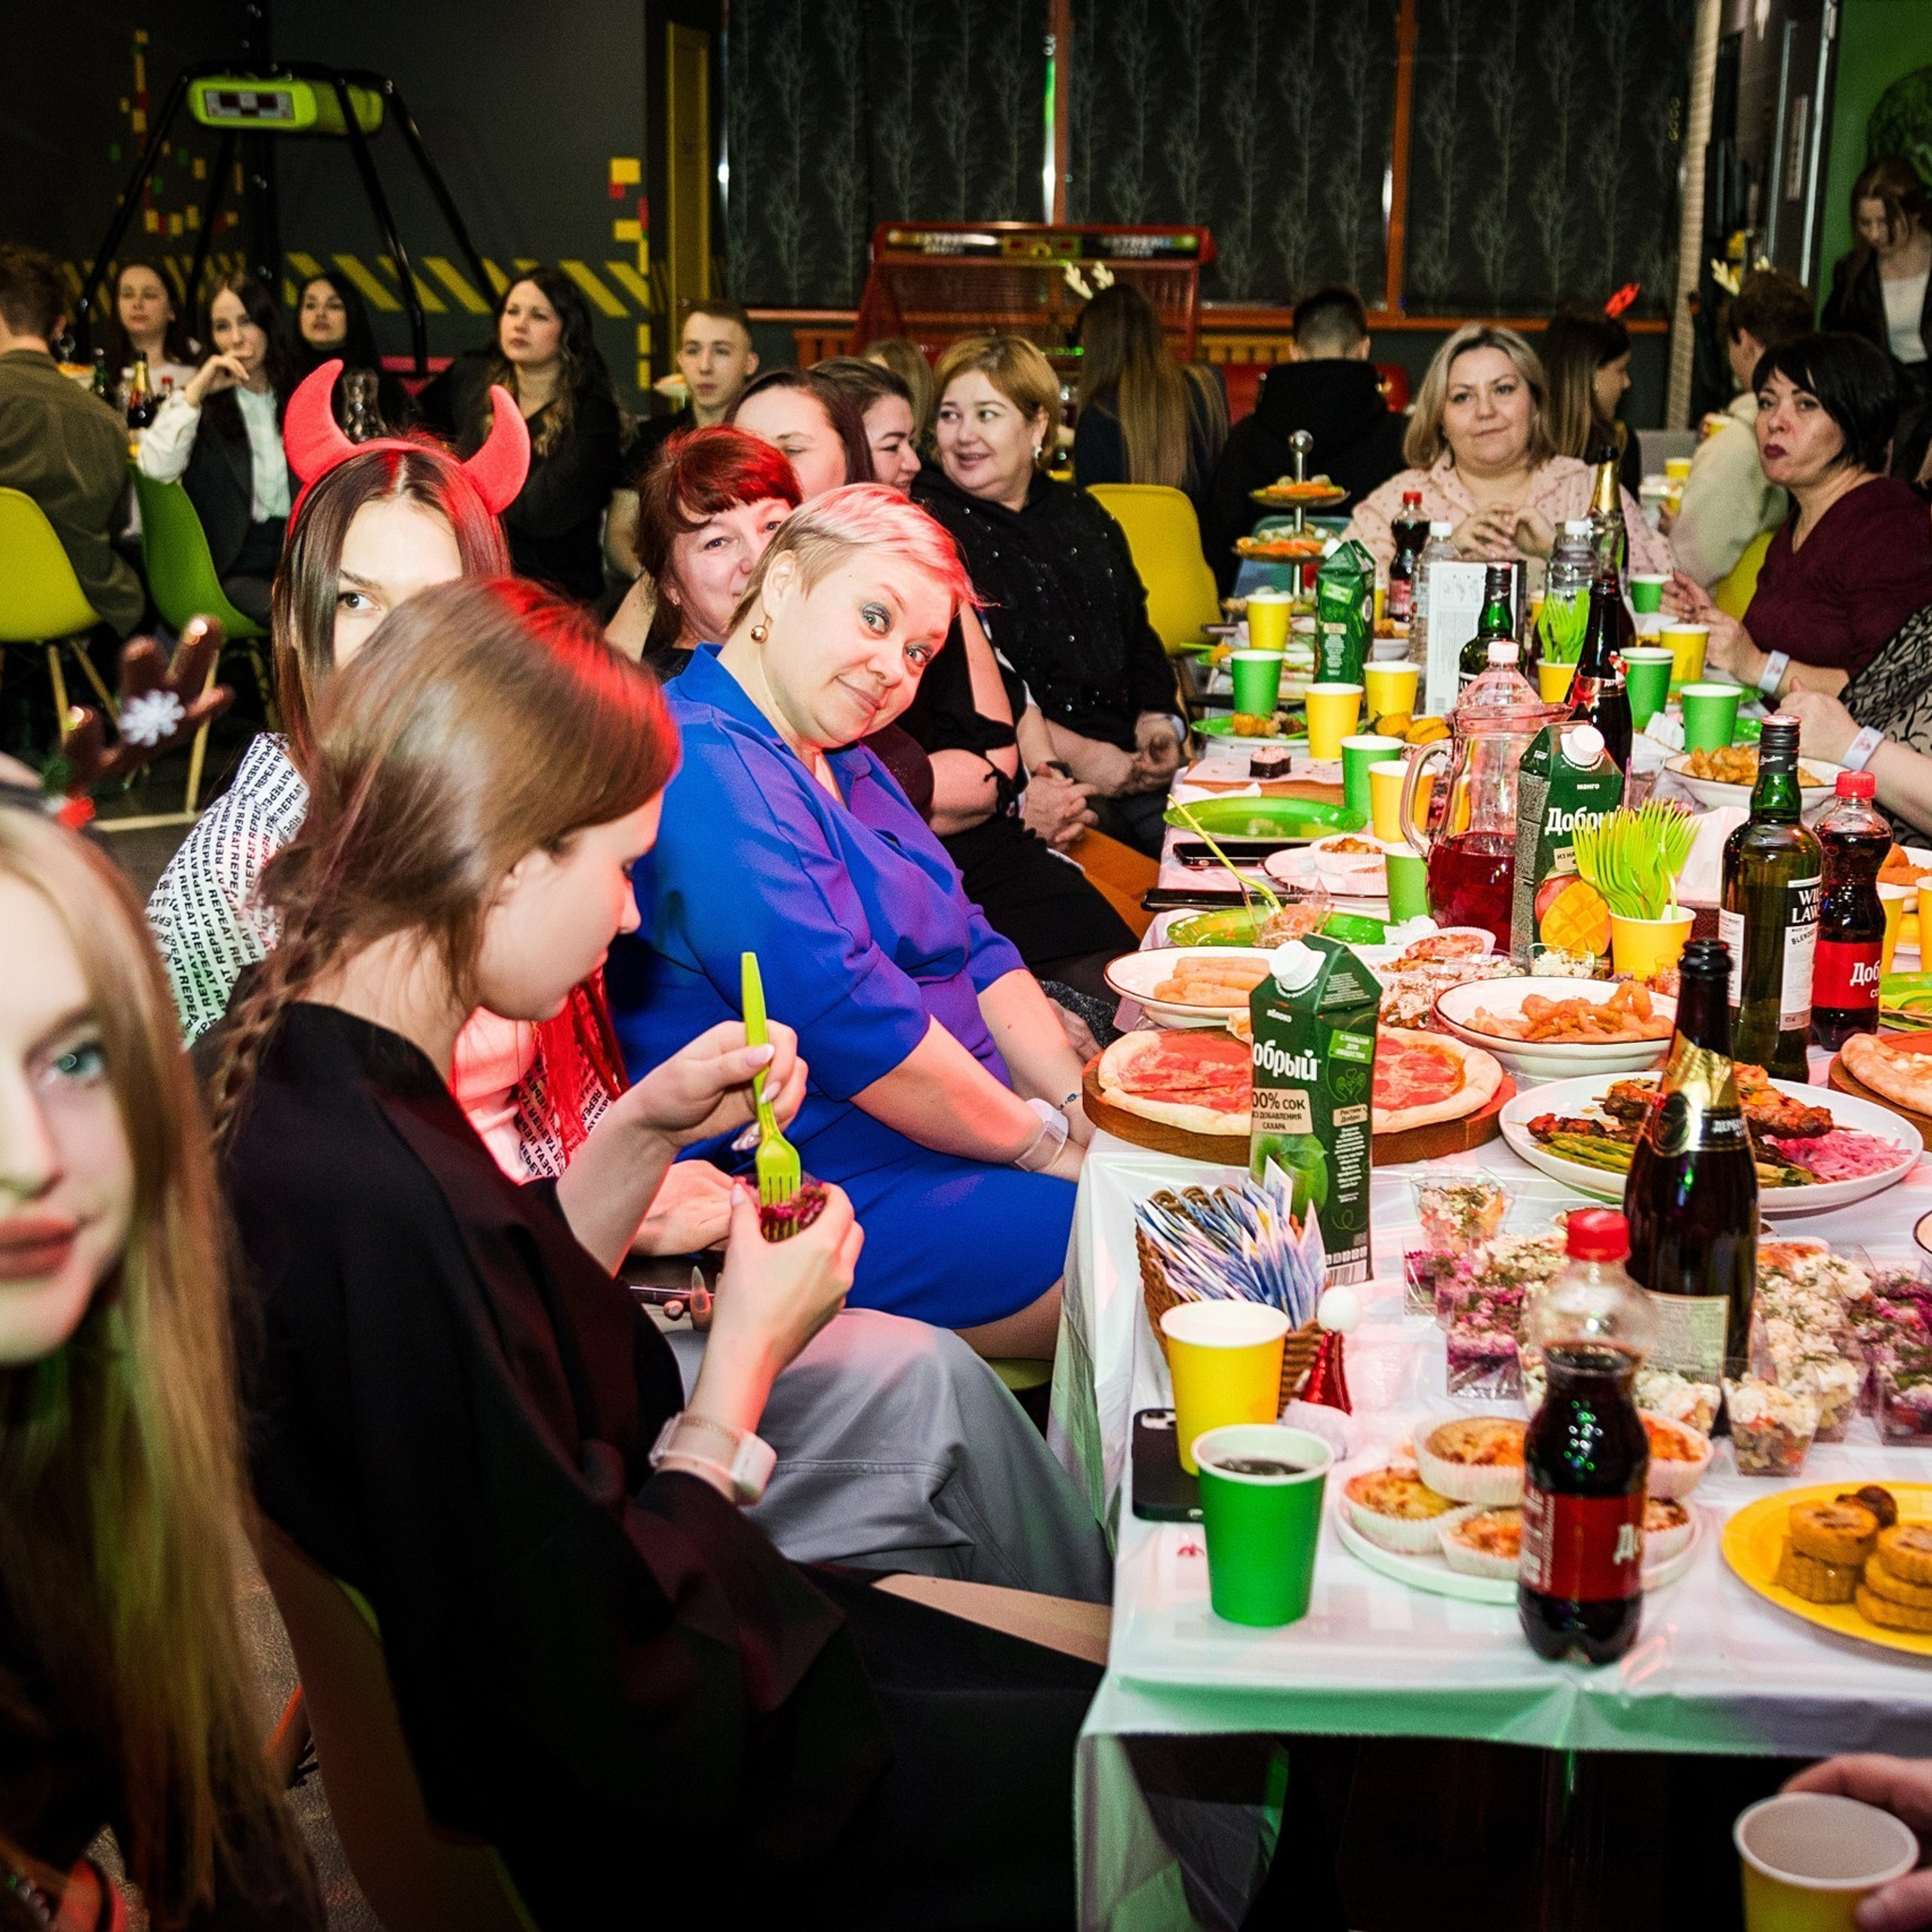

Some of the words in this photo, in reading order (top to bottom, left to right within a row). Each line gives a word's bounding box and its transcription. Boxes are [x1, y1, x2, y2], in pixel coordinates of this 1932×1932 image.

[254, 762, 278, 788] REPEAT
[277, 783, 305, 816] REPEAT
[232, 812, 245, 851] REPEAT
[248, 804, 262, 839] REPEAT
[1544, 804, 1621, 836] Добр
[215, 824, 227, 864] REPEAT
[190, 856, 206, 907] REPEAT
[245, 841, 256, 888] REPEAT
[202, 836, 214, 884] REPEAT
[208, 889, 236, 943] REPEAT
[179, 875, 198, 928] REPEAT
[190, 931, 219, 986] REPEAT
[201, 912, 226, 964] REPEAT
[188, 952, 212, 1008] REPEAT
[1266, 1009, 1292, 1023] яблоко
[1260, 1112, 1303, 1121] ДОБАВЛЕНИЯ
[1262, 1122, 1287, 1131] САХАРА
